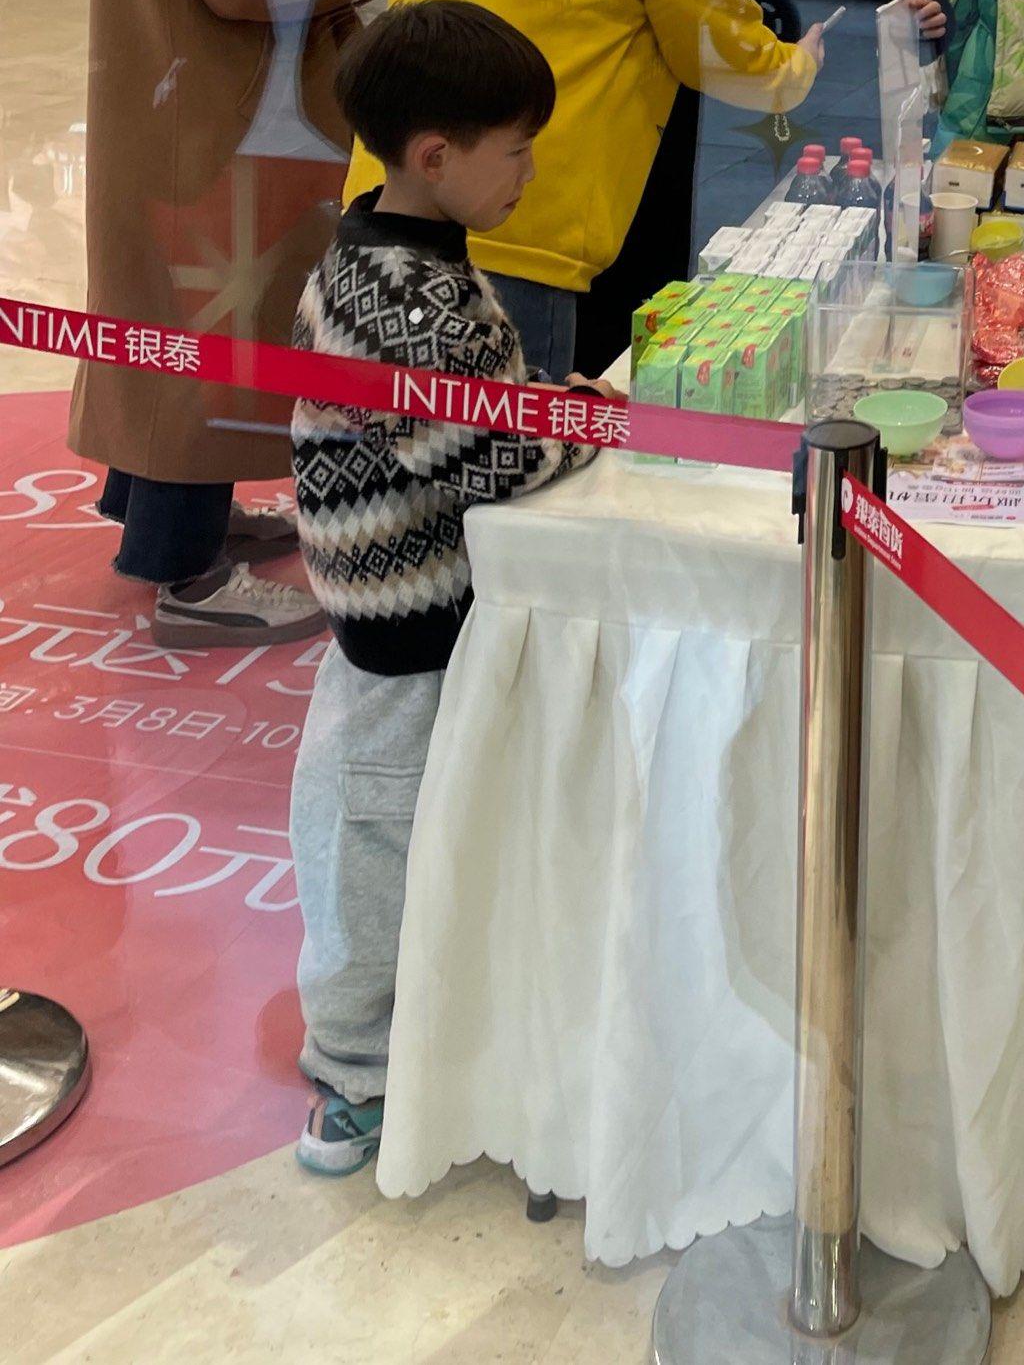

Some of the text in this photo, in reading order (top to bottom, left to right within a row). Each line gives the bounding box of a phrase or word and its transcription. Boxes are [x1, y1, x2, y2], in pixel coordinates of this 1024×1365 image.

[124, 326, 201, 373] 银泰
[393, 371, 632, 445] INTIME 银泰
